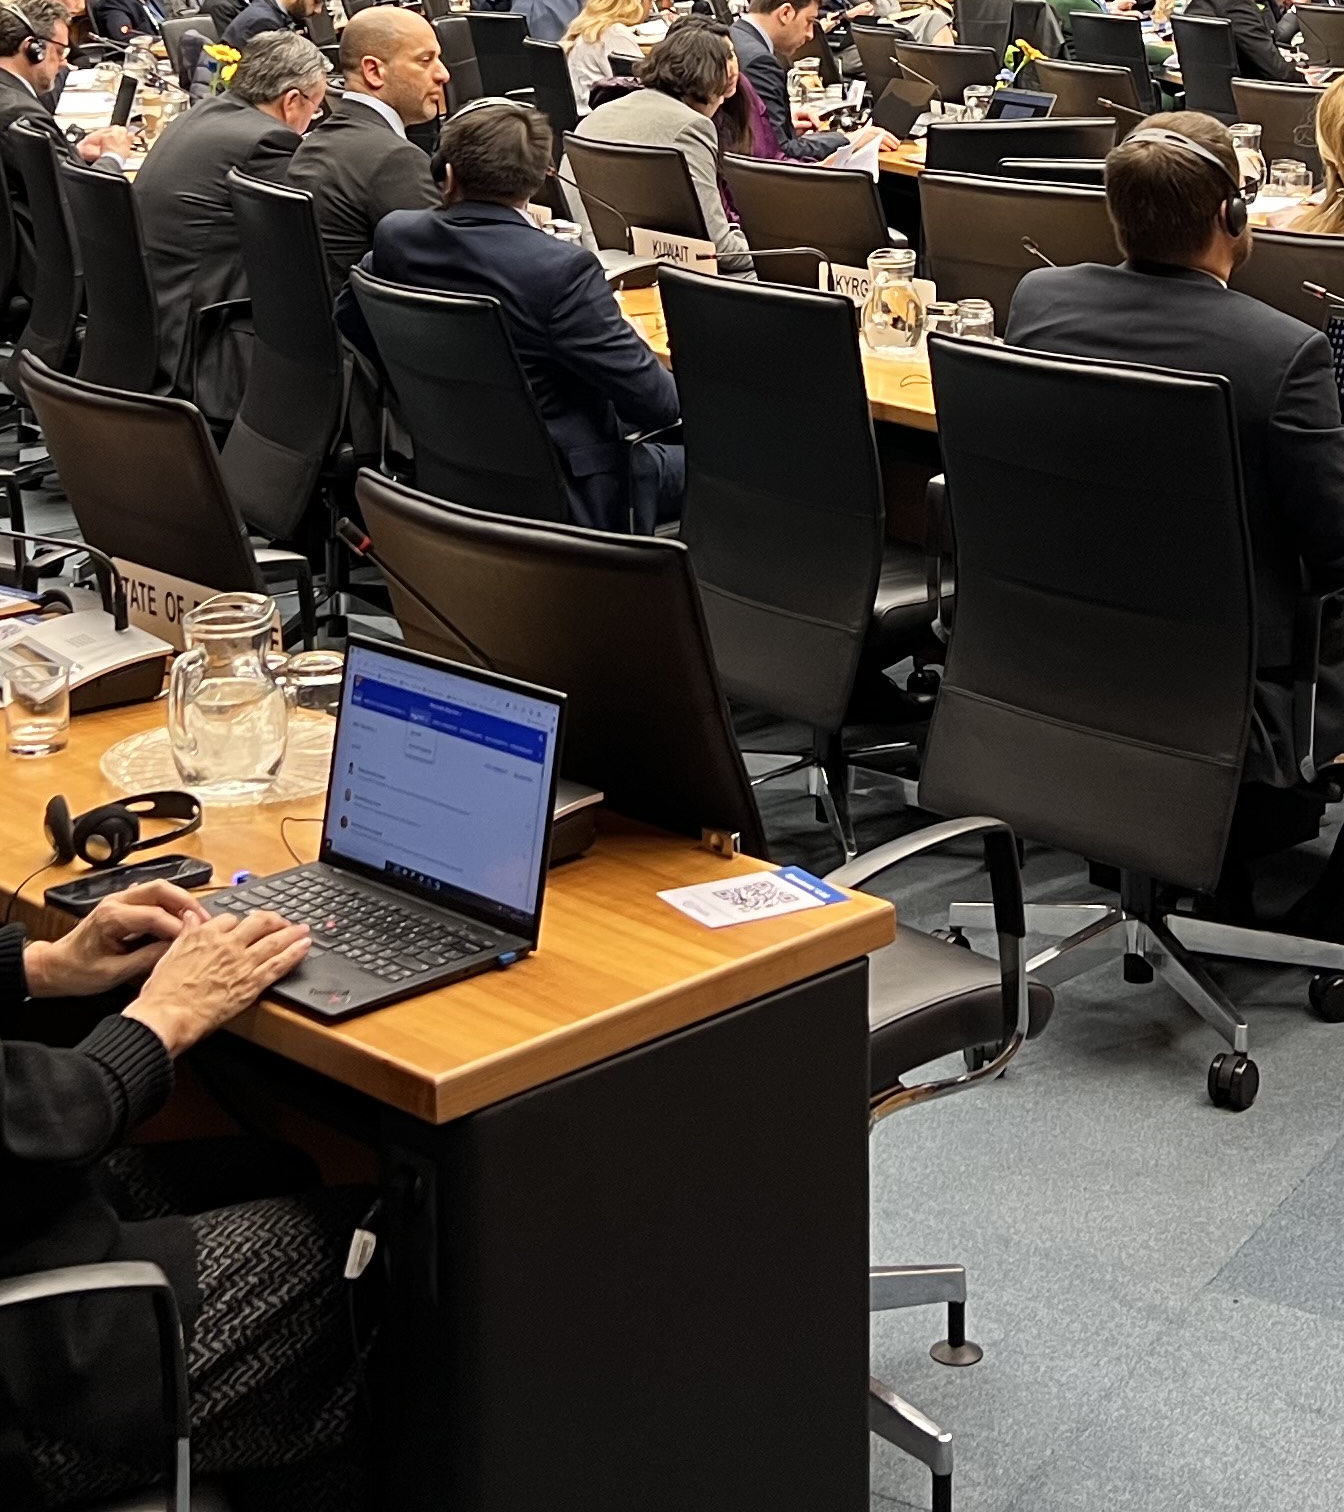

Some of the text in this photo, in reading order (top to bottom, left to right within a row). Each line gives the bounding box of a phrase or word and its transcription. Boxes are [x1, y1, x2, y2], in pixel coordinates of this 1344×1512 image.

[652, 239, 689, 263] KUWAIT
[119, 577, 184, 625] TATE OF
